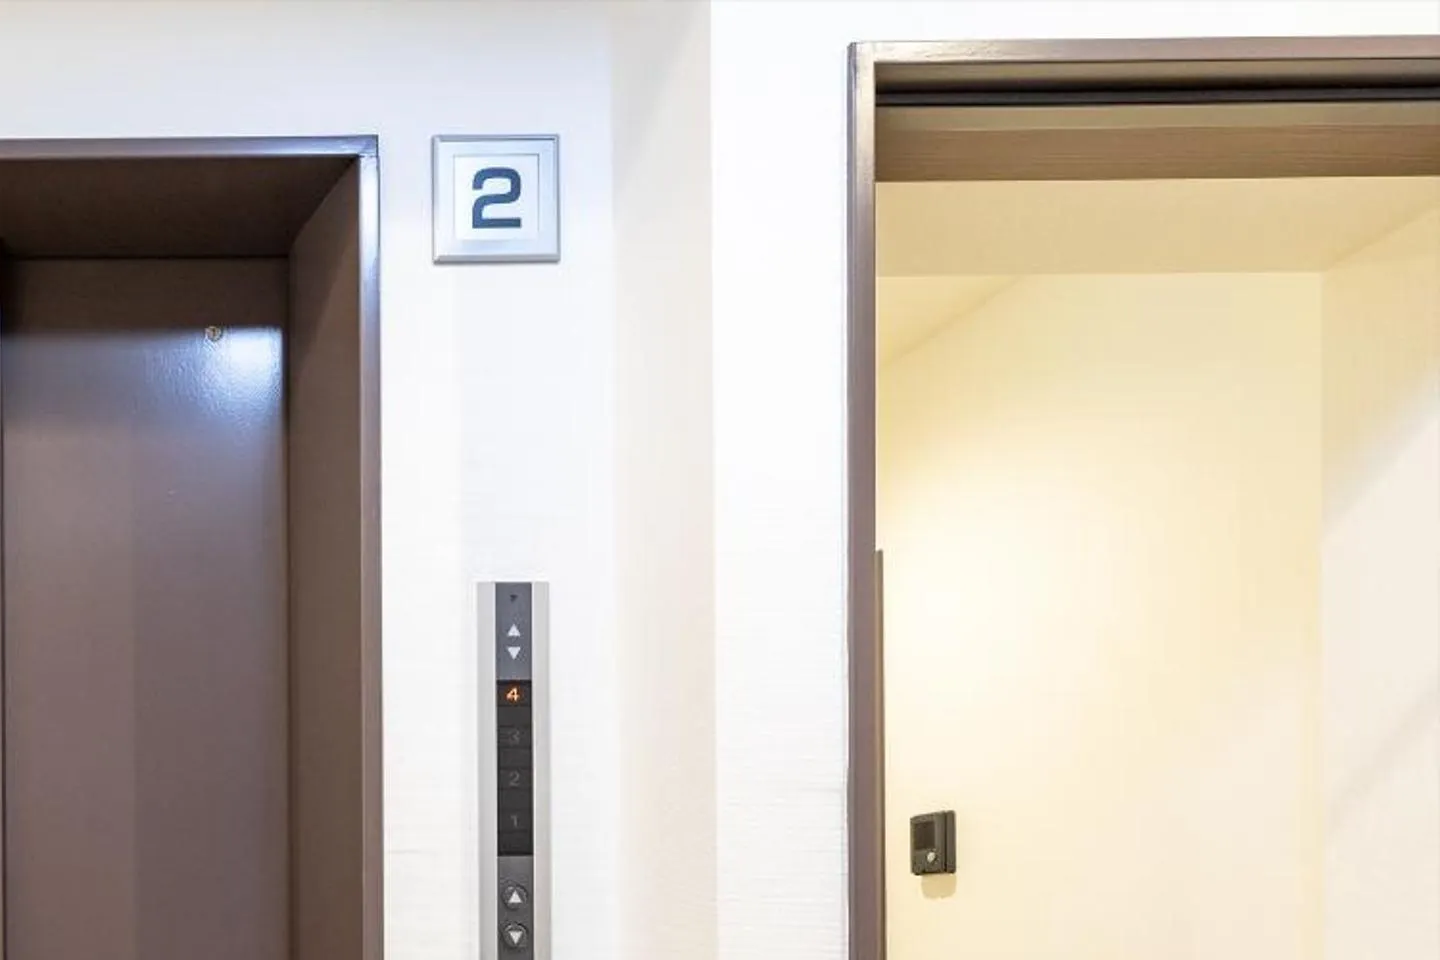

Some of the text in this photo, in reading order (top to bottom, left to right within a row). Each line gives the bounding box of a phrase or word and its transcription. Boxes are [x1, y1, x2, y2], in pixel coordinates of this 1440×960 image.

[472, 167, 522, 229] 2
[506, 687, 520, 702] 4
[508, 729, 521, 745] 3
[509, 771, 520, 787] 2
[510, 814, 519, 828] 1
